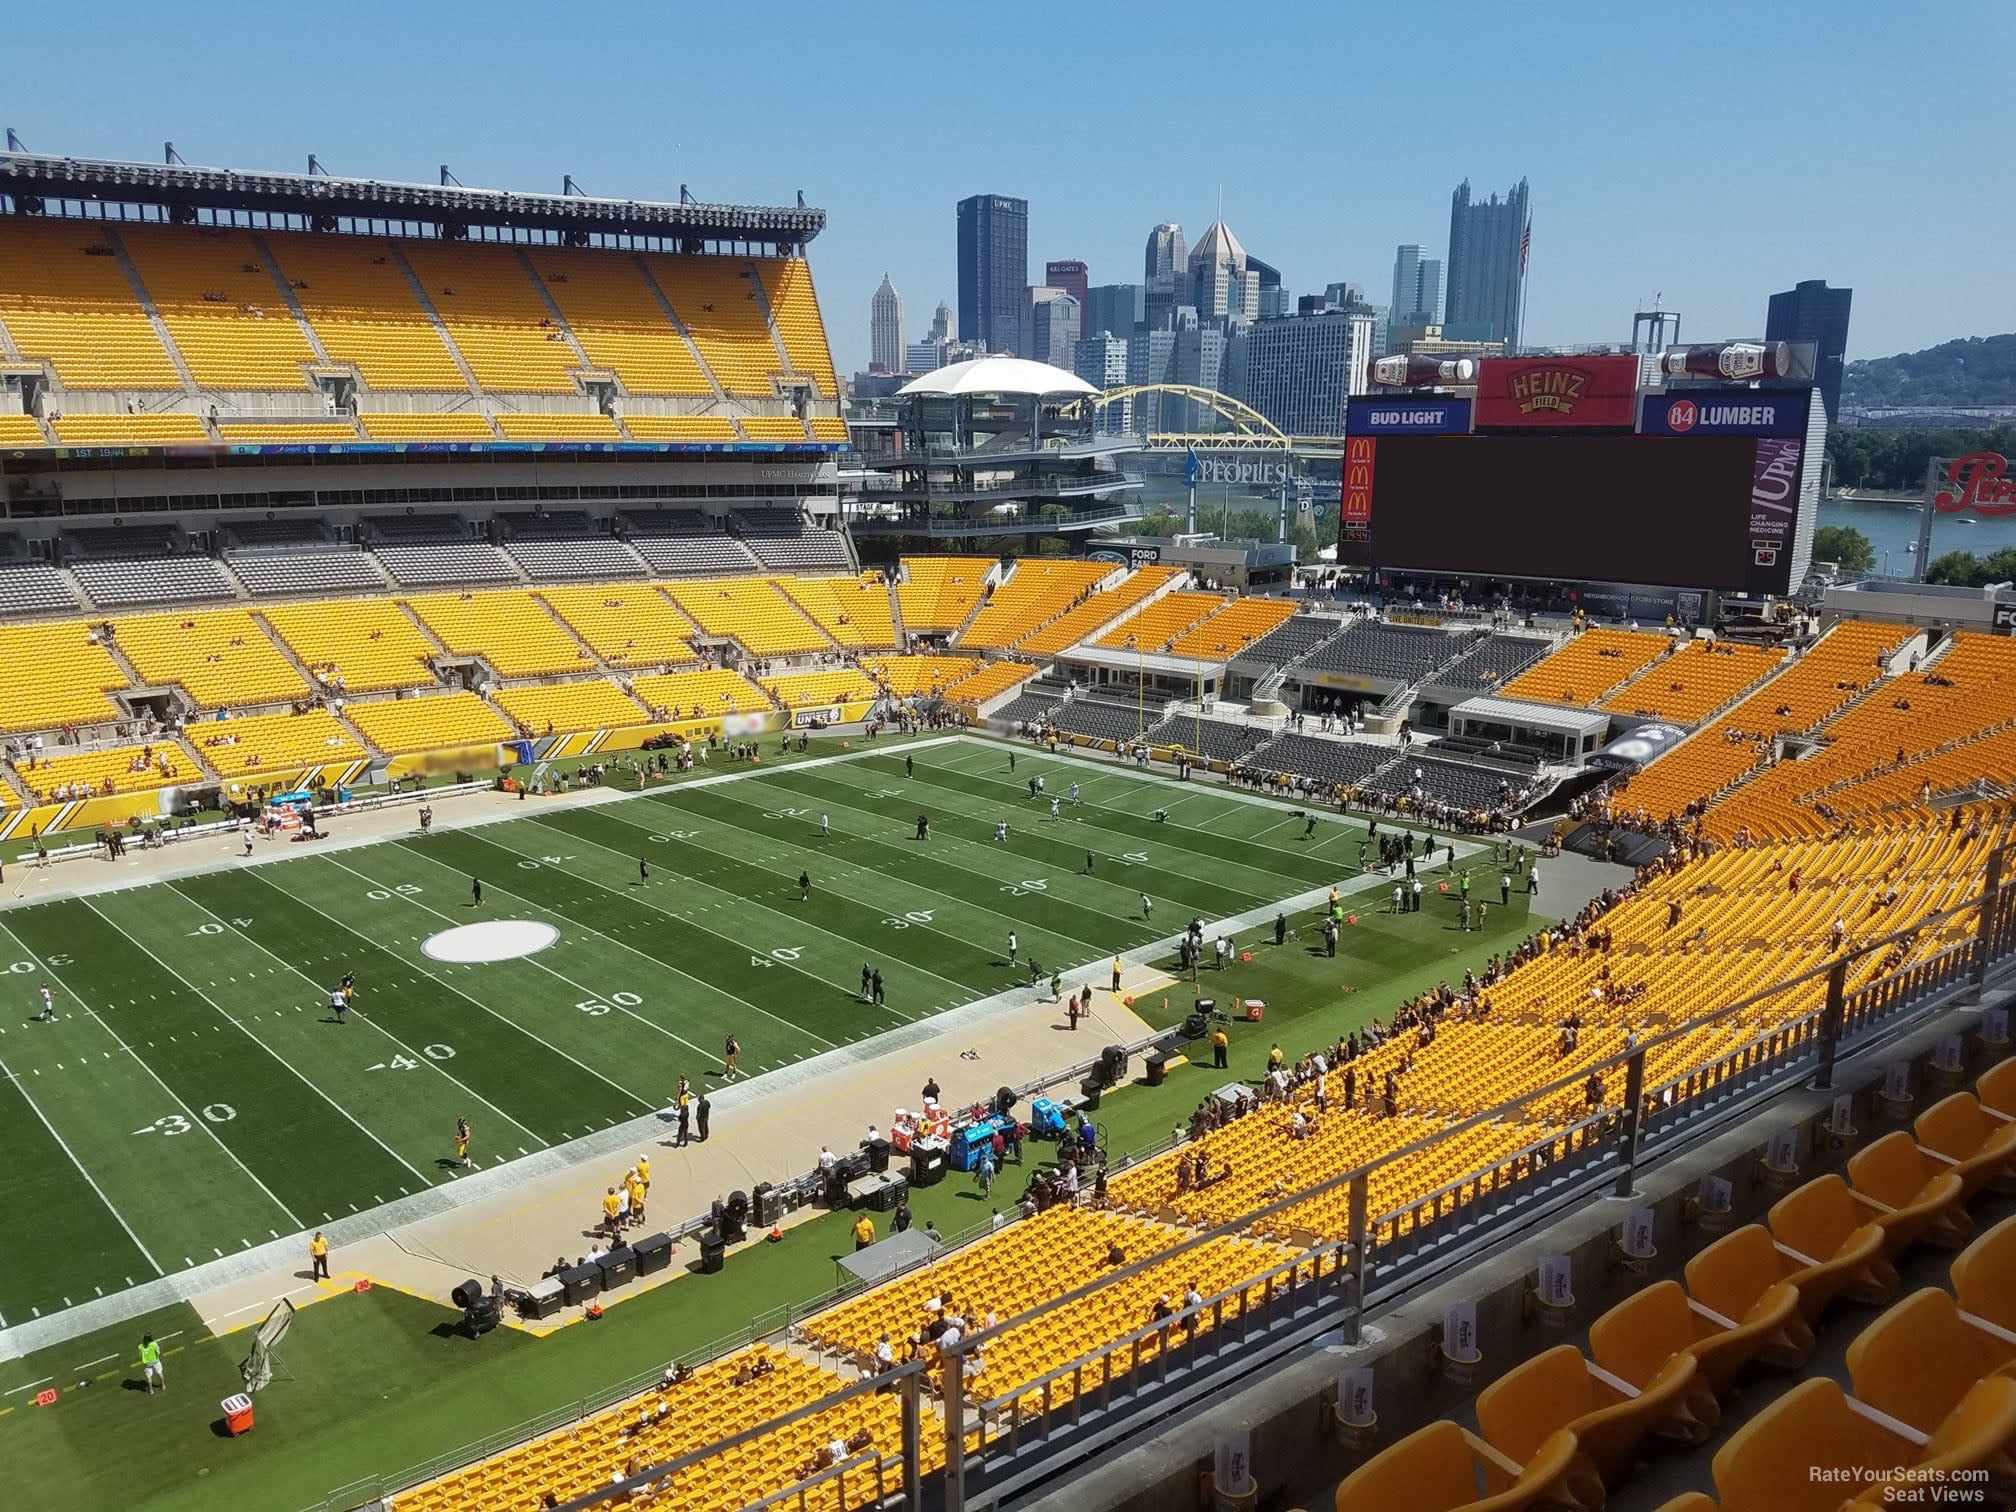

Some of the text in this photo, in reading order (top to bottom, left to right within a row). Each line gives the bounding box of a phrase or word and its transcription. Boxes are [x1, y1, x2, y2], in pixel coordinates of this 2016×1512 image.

[994, 199, 1013, 210] UPMC
[1060, 265, 1080, 273] GATES
[1513, 371, 1585, 399] HEINZ
[1535, 397, 1557, 407] FIELD
[1370, 411, 1444, 425] BUD LIGHT
[1670, 406, 1775, 426] 84 LUMBER
[75, 448, 92, 457] 1ST
[761, 470, 787, 478] UPMC
[1201, 459, 1287, 484] PEOPLES
[1752, 443, 1800, 501] UPMC
[1750, 520, 1788, 529] CHANGING
[1749, 526, 1784, 535] MEDICINE
[1131, 549, 1157, 560] FORD
[1403, 614, 1425, 625] UNITED
[574, 991, 644, 1017] 50
[40, 1390, 57, 1402] 20
